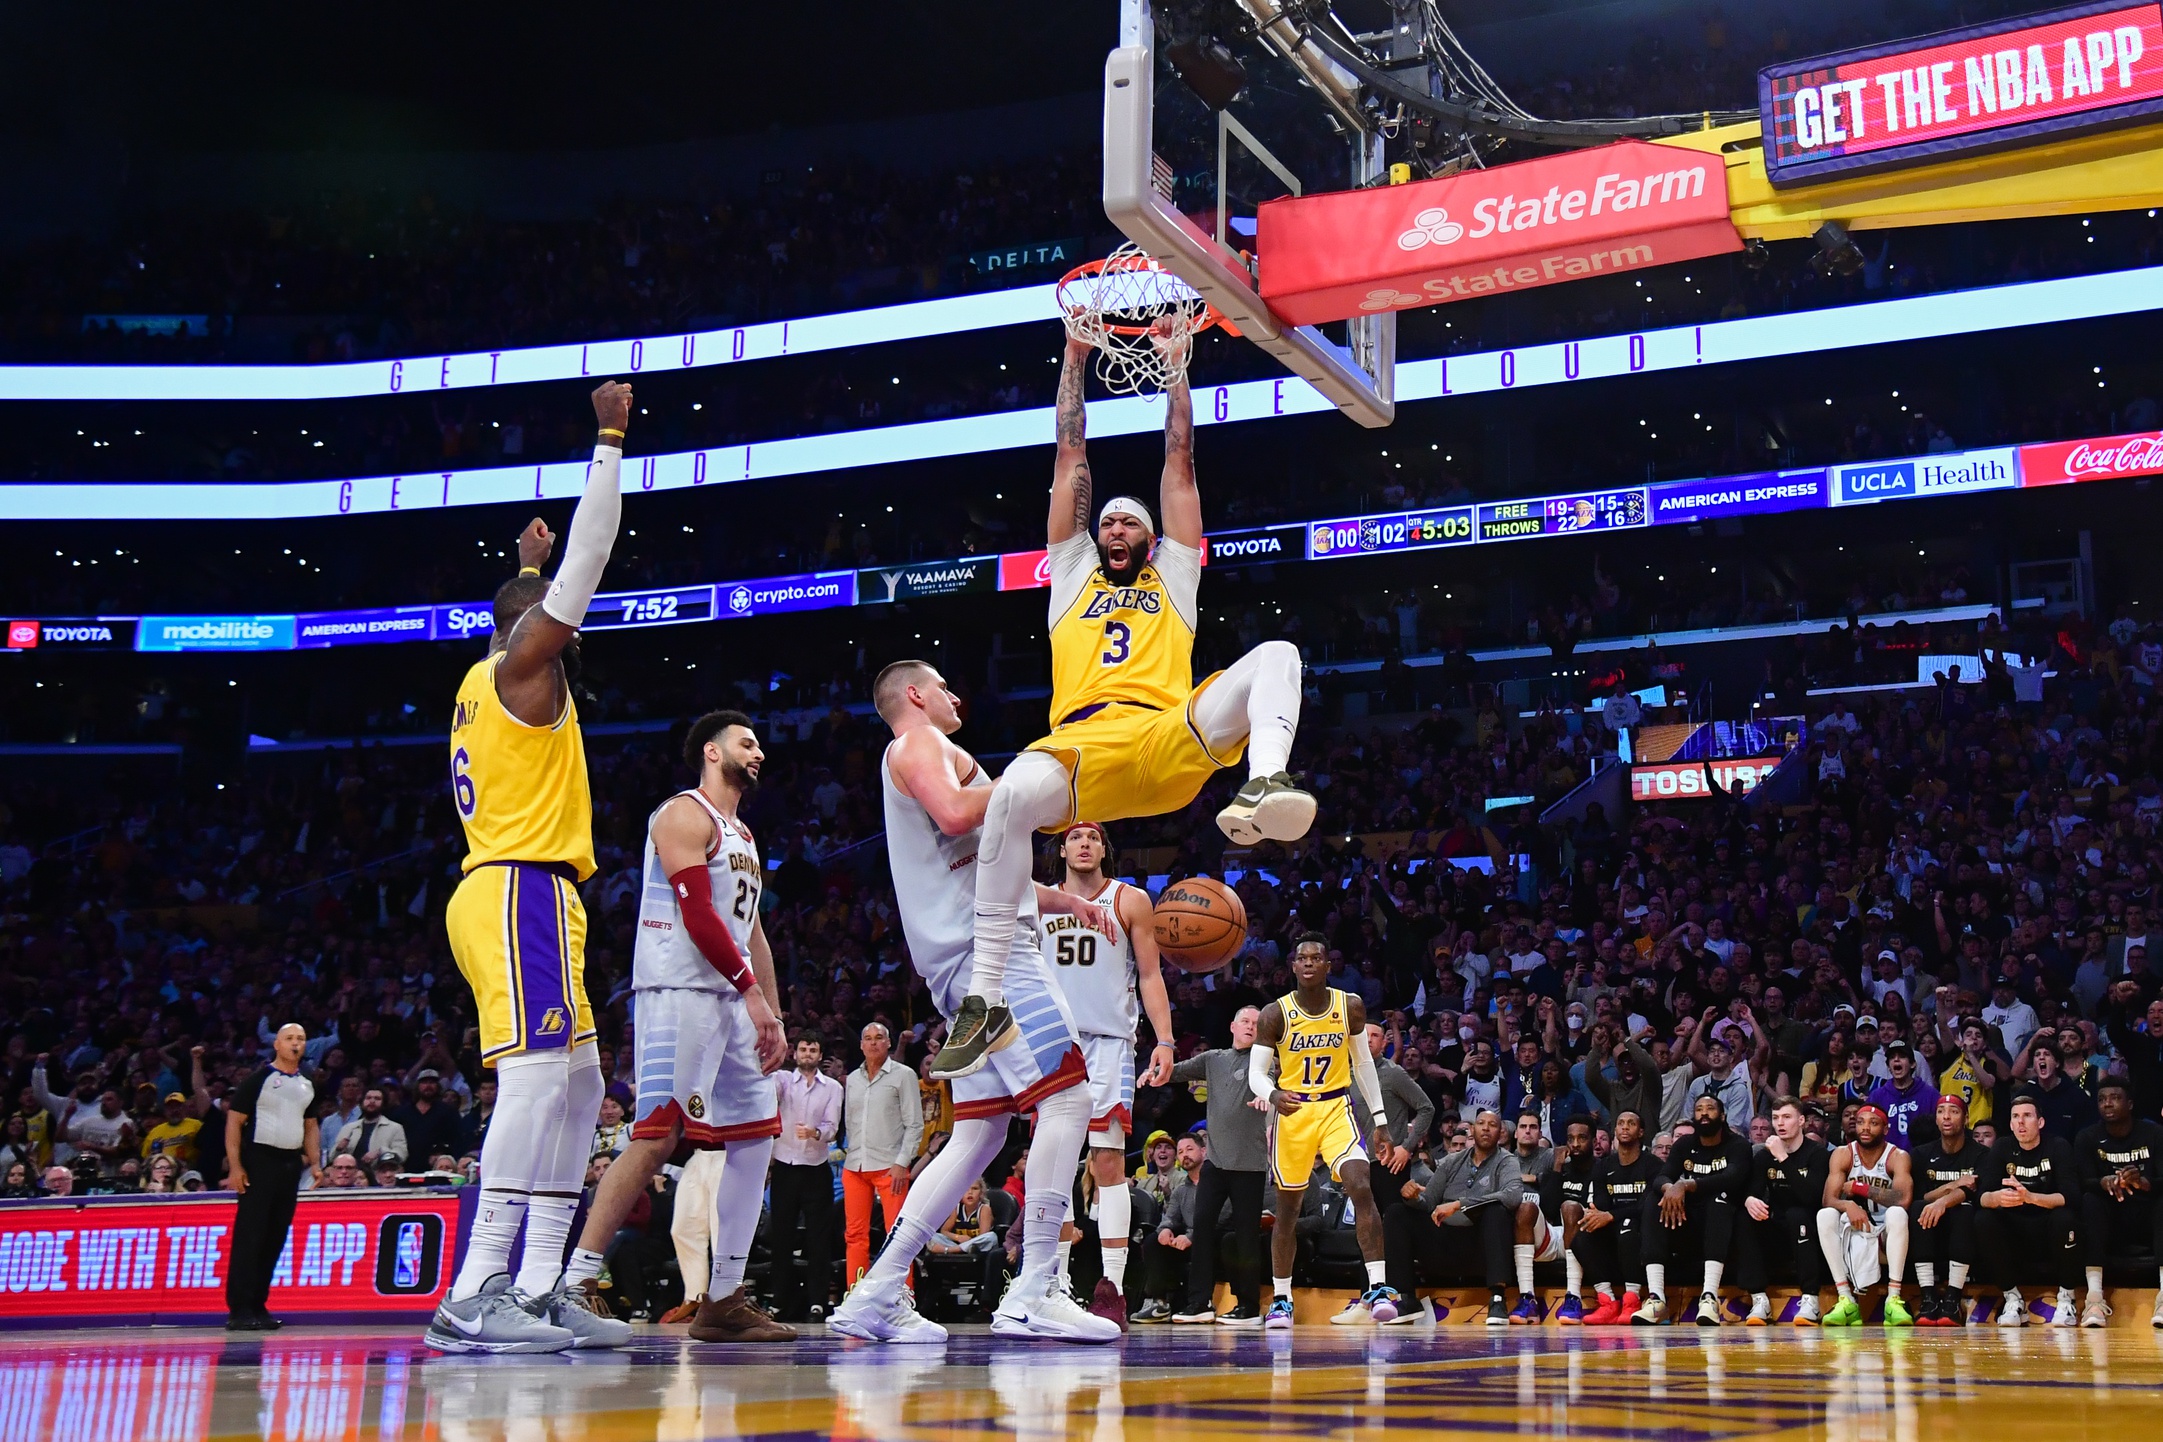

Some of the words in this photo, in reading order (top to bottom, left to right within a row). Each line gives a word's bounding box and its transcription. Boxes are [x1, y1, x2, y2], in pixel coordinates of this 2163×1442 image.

[1794, 77, 1867, 149] GET
[1875, 61, 1958, 133] THE
[1964, 45, 2053, 117] NBA
[2062, 26, 2144, 100] APP
[1214, 380, 1285, 421] GE
[534, 446, 751, 500] LUD!
[1851, 471, 1907, 493] UCLA
[1923, 460, 2006, 487] Health
[1659, 490, 1741, 511] AMERICAN
[1744, 483, 1818, 502] EXPRESS
[1408, 518, 1422, 527] QTR
[1495, 504, 1529, 519] FREE
[1605, 511, 1625, 527] 16
[1375, 524, 1405, 544] 102
[1411, 528, 1420, 541] 4
[1422, 517, 1470, 540] 5:03
[1483, 520, 1540, 537] THROWS
[1558, 516, 1578, 532] 22
[1212, 538, 1281, 557] TOYOTA
[1328, 528, 1357, 549] 100
[754, 583, 839, 606] crypto.com
[1079, 588, 1162, 619] LAKERS
[622, 597, 678, 621] 7:52
[43, 628, 113, 642] TOYOTA
[163, 622, 275, 640] mobilitie
[302, 622, 365, 637] AMERICAN
[367, 617, 426, 633] EXPRESS
[1102, 620, 1132, 669] 3
[451, 745, 478, 818] 6
[949, 853, 979, 872] NUGGET
[733, 877, 758, 924] 27
[642, 919, 673, 930] NUGGETS
[1056, 935, 1097, 966] 50
[1288, 1032, 1345, 1052] LAKERS
[1302, 1056, 1333, 1087] 17
[1898, 1113, 1909, 1135] 6
[78, 1229, 160, 1291] WITH
[166, 1226, 228, 1289] THE
[299, 1223, 367, 1287] APP
